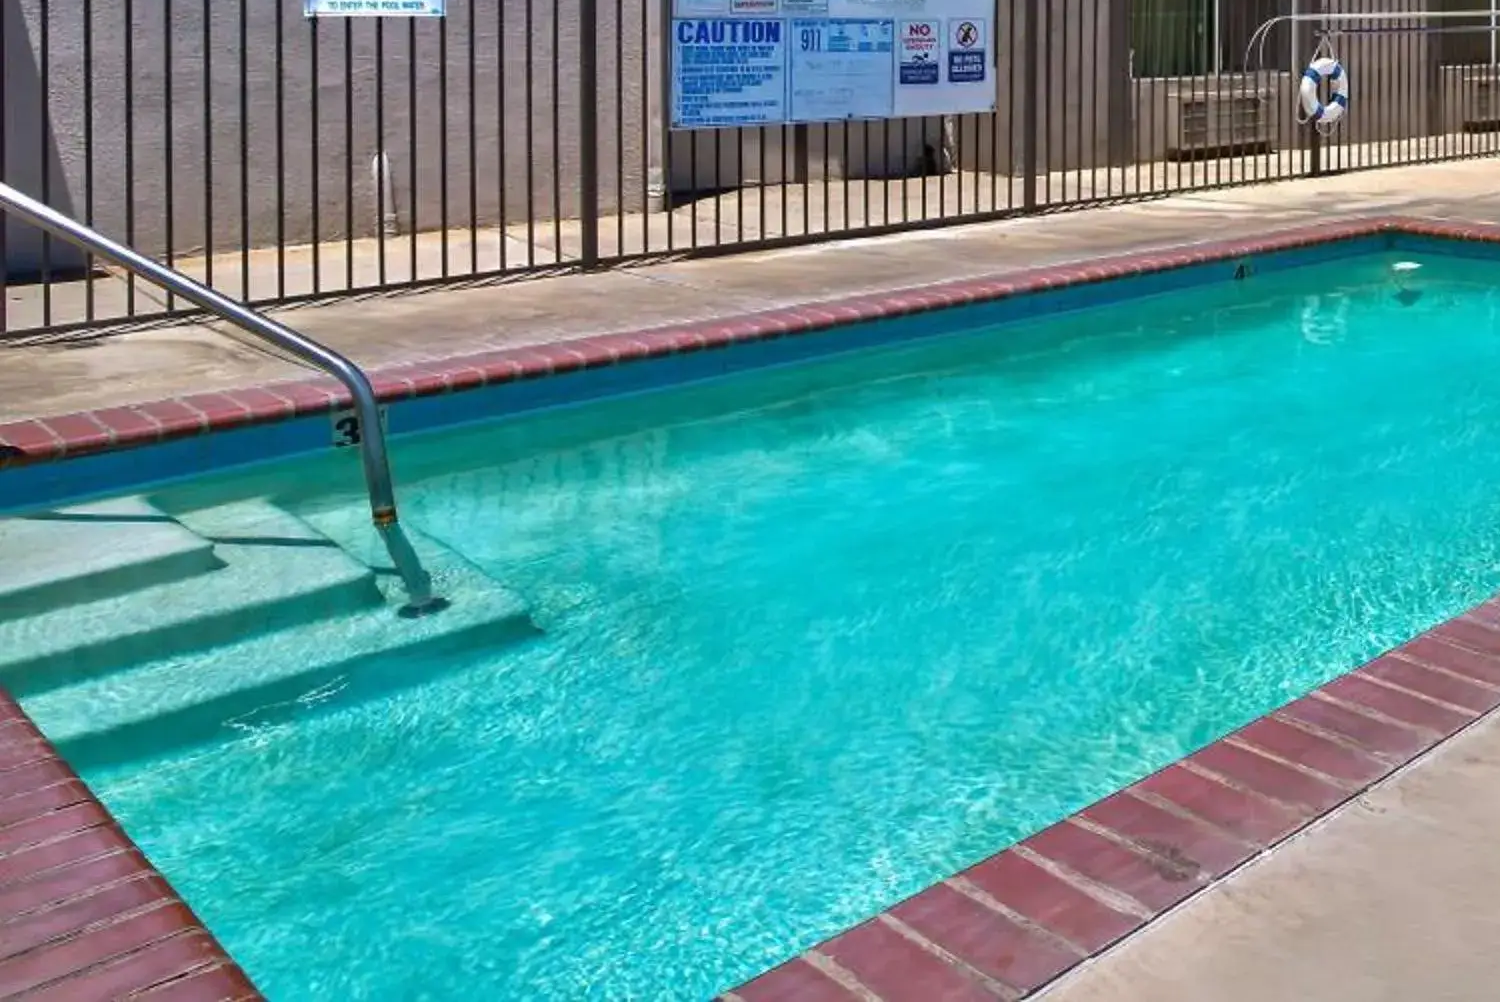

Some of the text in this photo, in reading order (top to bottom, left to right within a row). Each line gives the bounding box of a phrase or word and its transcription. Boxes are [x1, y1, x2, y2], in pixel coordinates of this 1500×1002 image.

[677, 21, 780, 44] CAUTION
[801, 29, 821, 52] 911
[909, 23, 931, 36] NO
[335, 417, 360, 448] 3
